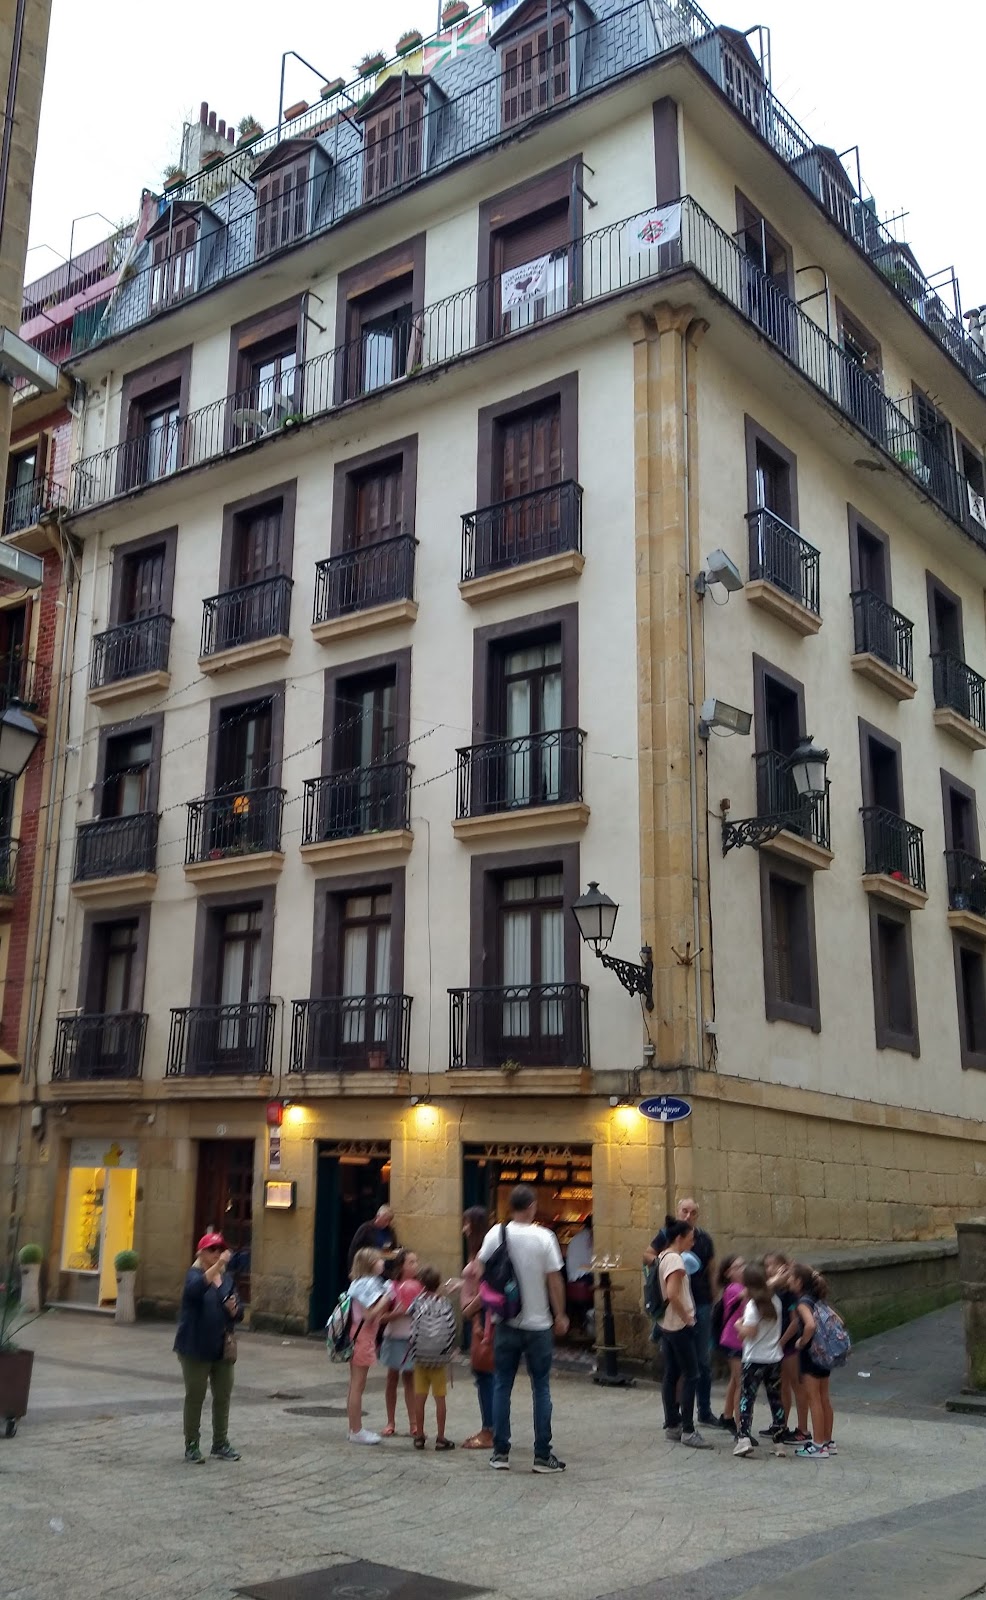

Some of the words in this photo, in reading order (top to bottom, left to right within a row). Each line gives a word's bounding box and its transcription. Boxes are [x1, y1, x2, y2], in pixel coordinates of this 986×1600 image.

[647, 1105, 662, 1113] Calle
[663, 1106, 680, 1114] Mayor
[484, 1144, 573, 1161] VERGARA
